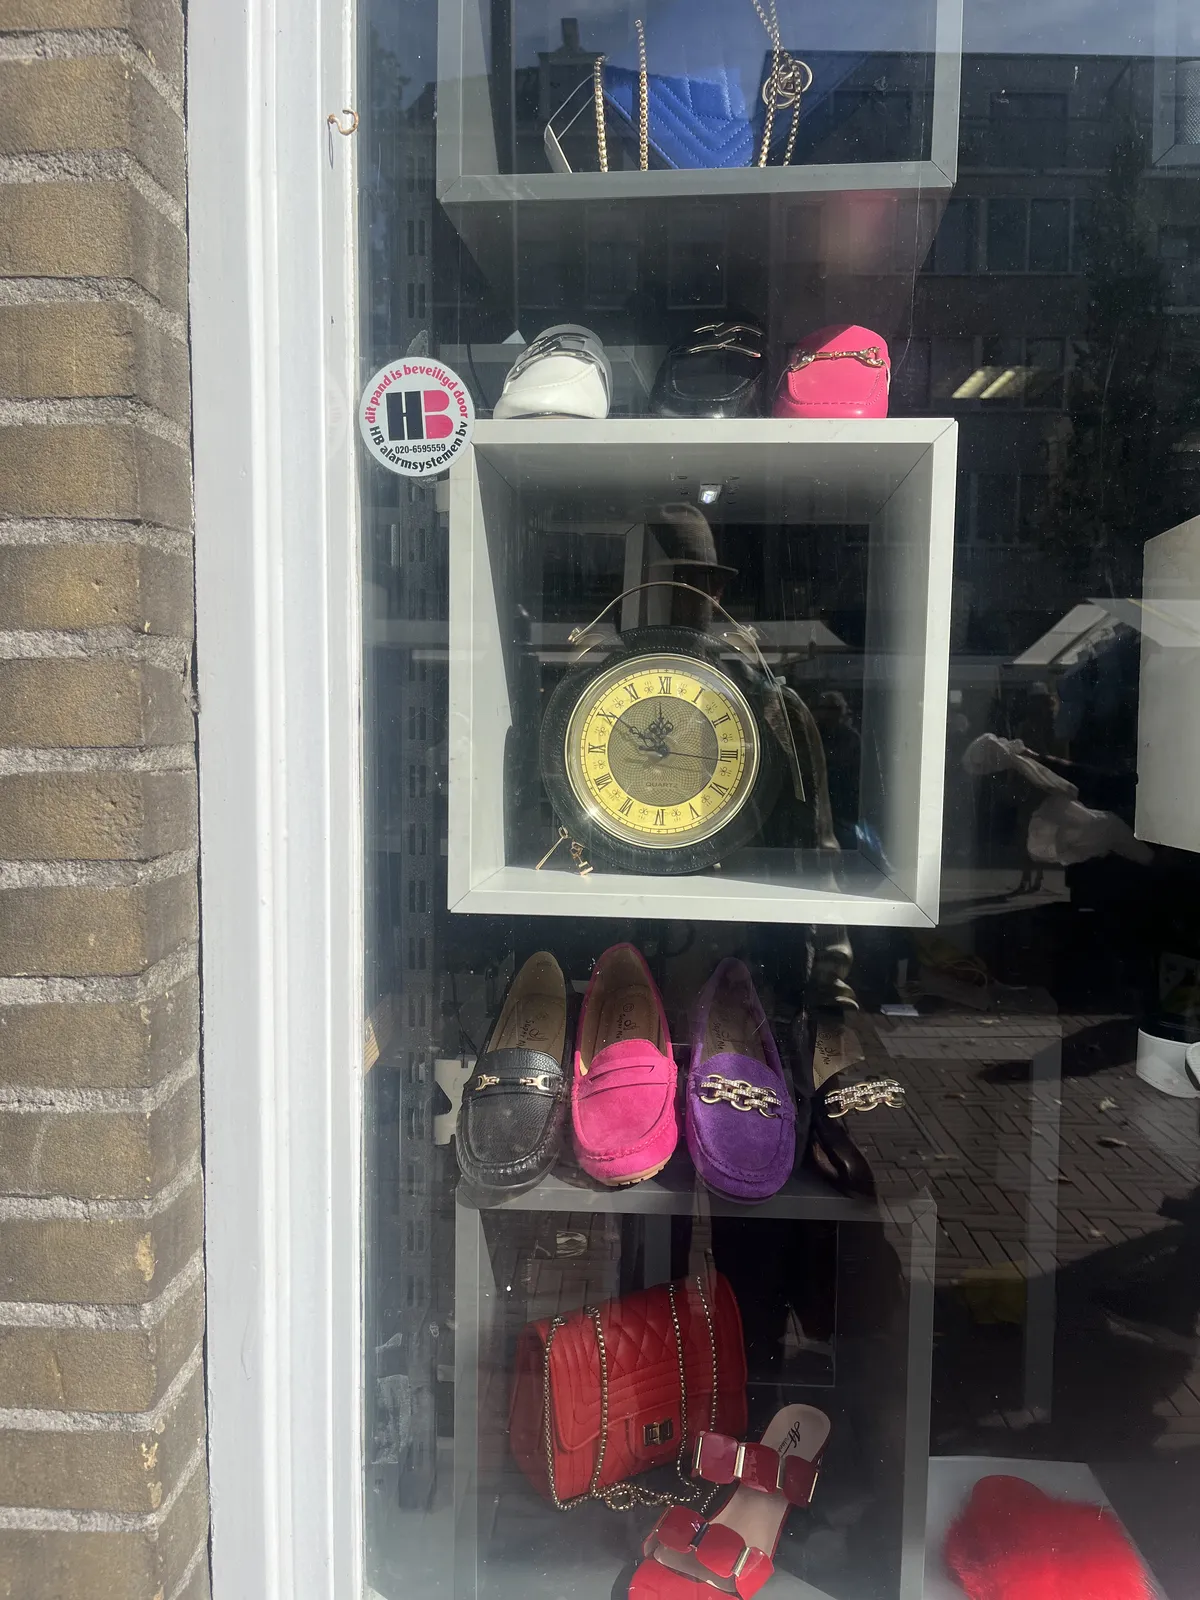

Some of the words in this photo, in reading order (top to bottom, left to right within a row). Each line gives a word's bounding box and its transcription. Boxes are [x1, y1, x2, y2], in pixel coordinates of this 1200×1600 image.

[390, 369, 402, 381] is
[403, 364, 458, 391] beveiligd
[370, 375, 392, 406] pand
[365, 406, 377, 424] dit
[386, 390, 454, 441] HB
[453, 390, 469, 419] door
[369, 425, 385, 446] HB
[380, 438, 464, 473] alarmsystemen
[456, 421, 468, 437] bv
[395, 443, 446, 454] 020-6595559
[658, 676, 672, 694] XII
[645, 781, 678, 789] QUARTZ
